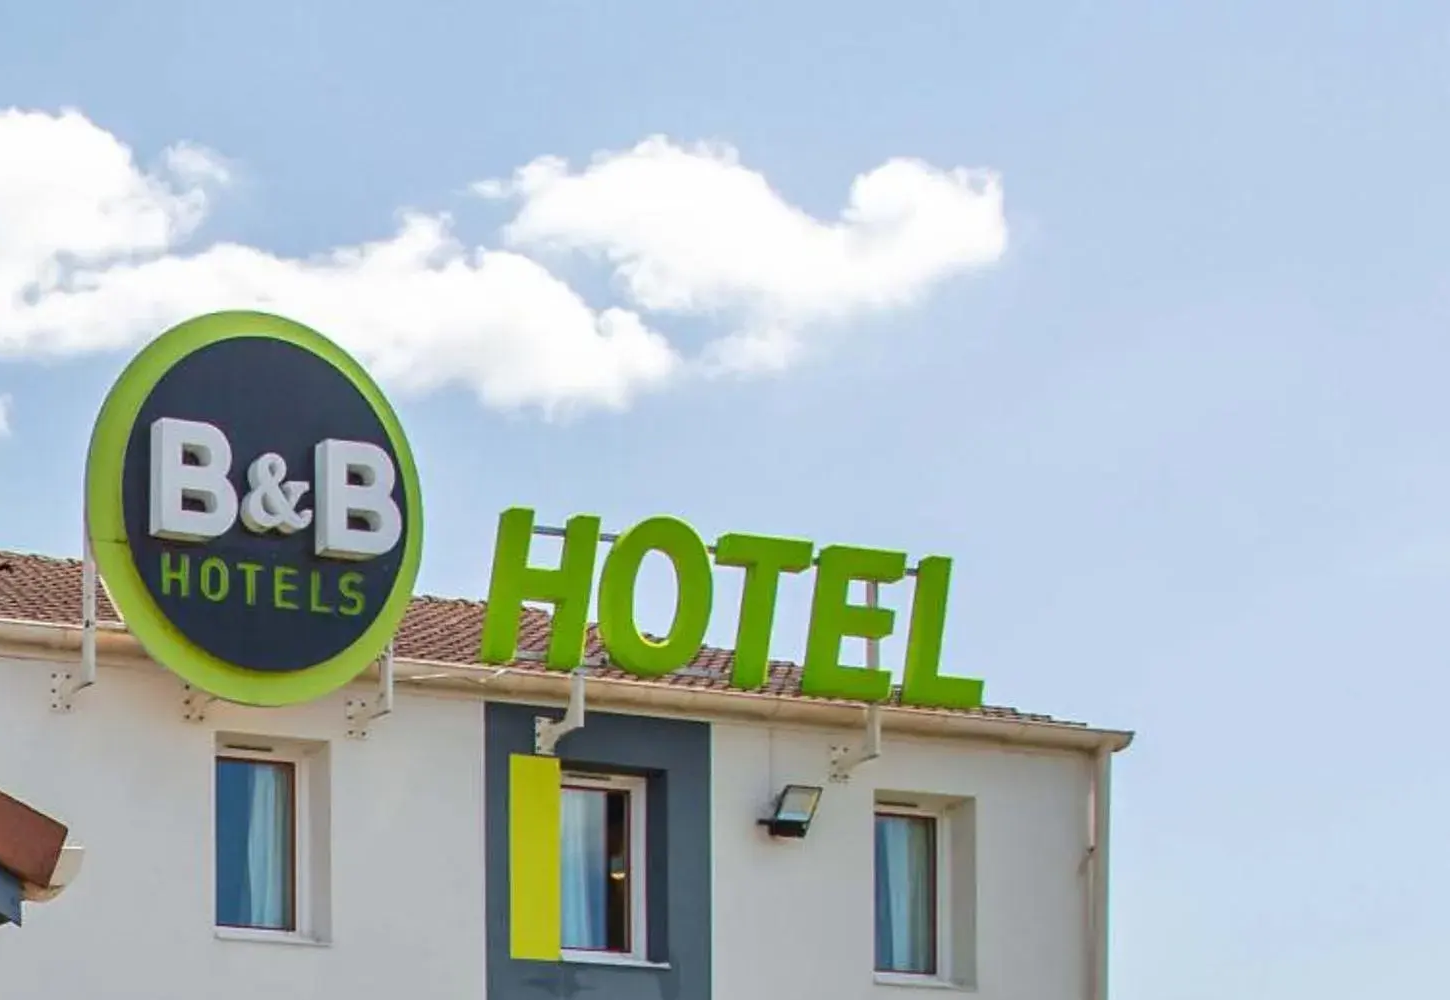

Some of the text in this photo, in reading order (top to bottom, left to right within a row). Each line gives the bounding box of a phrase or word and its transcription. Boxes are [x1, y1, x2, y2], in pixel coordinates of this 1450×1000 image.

[149, 416, 402, 561] B&B
[160, 552, 367, 607] HOTELS
[480, 506, 985, 708] HOTEL
